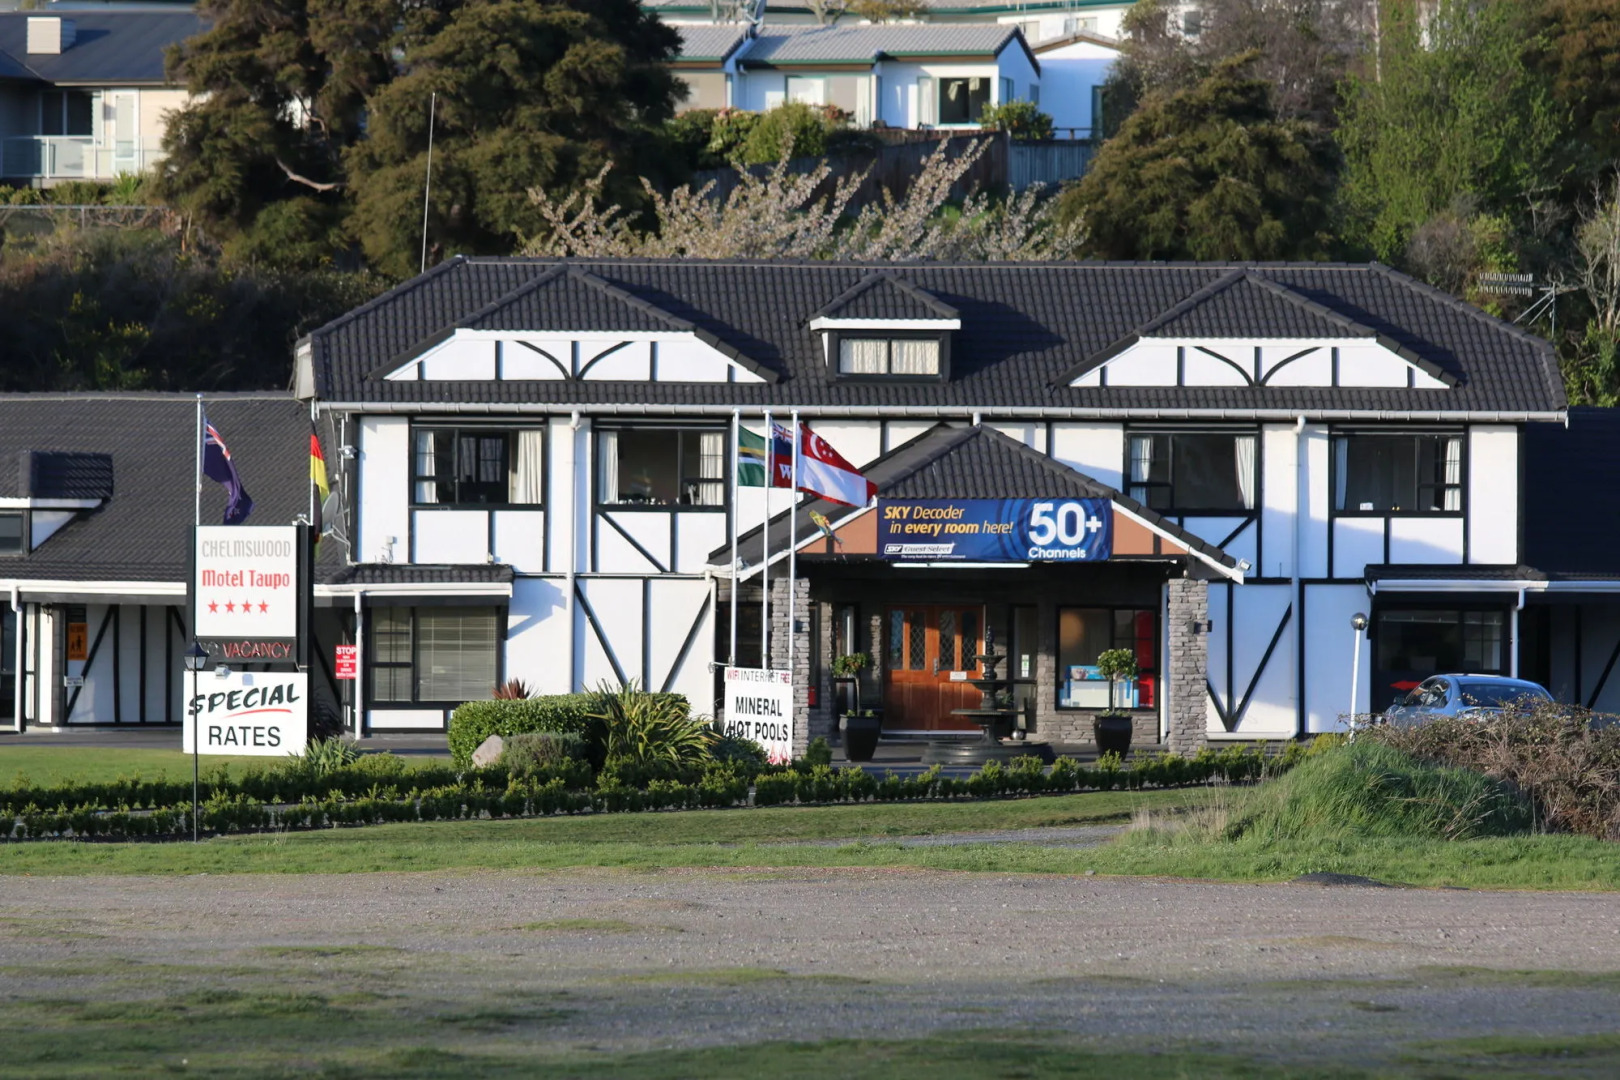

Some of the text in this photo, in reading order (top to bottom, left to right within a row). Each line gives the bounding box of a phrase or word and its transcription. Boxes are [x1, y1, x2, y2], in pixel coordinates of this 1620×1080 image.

[884, 505, 965, 519] SKY Decoder
[889, 520, 1014, 537] in every room here!
[1028, 502, 1102, 546] 50+
[201, 540, 292, 558] CHELMSWOOD
[904, 545, 926, 553] Guest
[928, 545, 950, 553] Select
[1028, 546, 1086, 558] Channels
[202, 569, 290, 590] Motel Taupo
[222, 641, 292, 658] VACANCY
[726, 669, 740, 680] WIFI
[188, 683, 300, 716] SPECIAL
[735, 696, 782, 717] MINERAL
[208, 725, 281, 747] RATES
[726, 720, 789, 742] HOT POOLS
